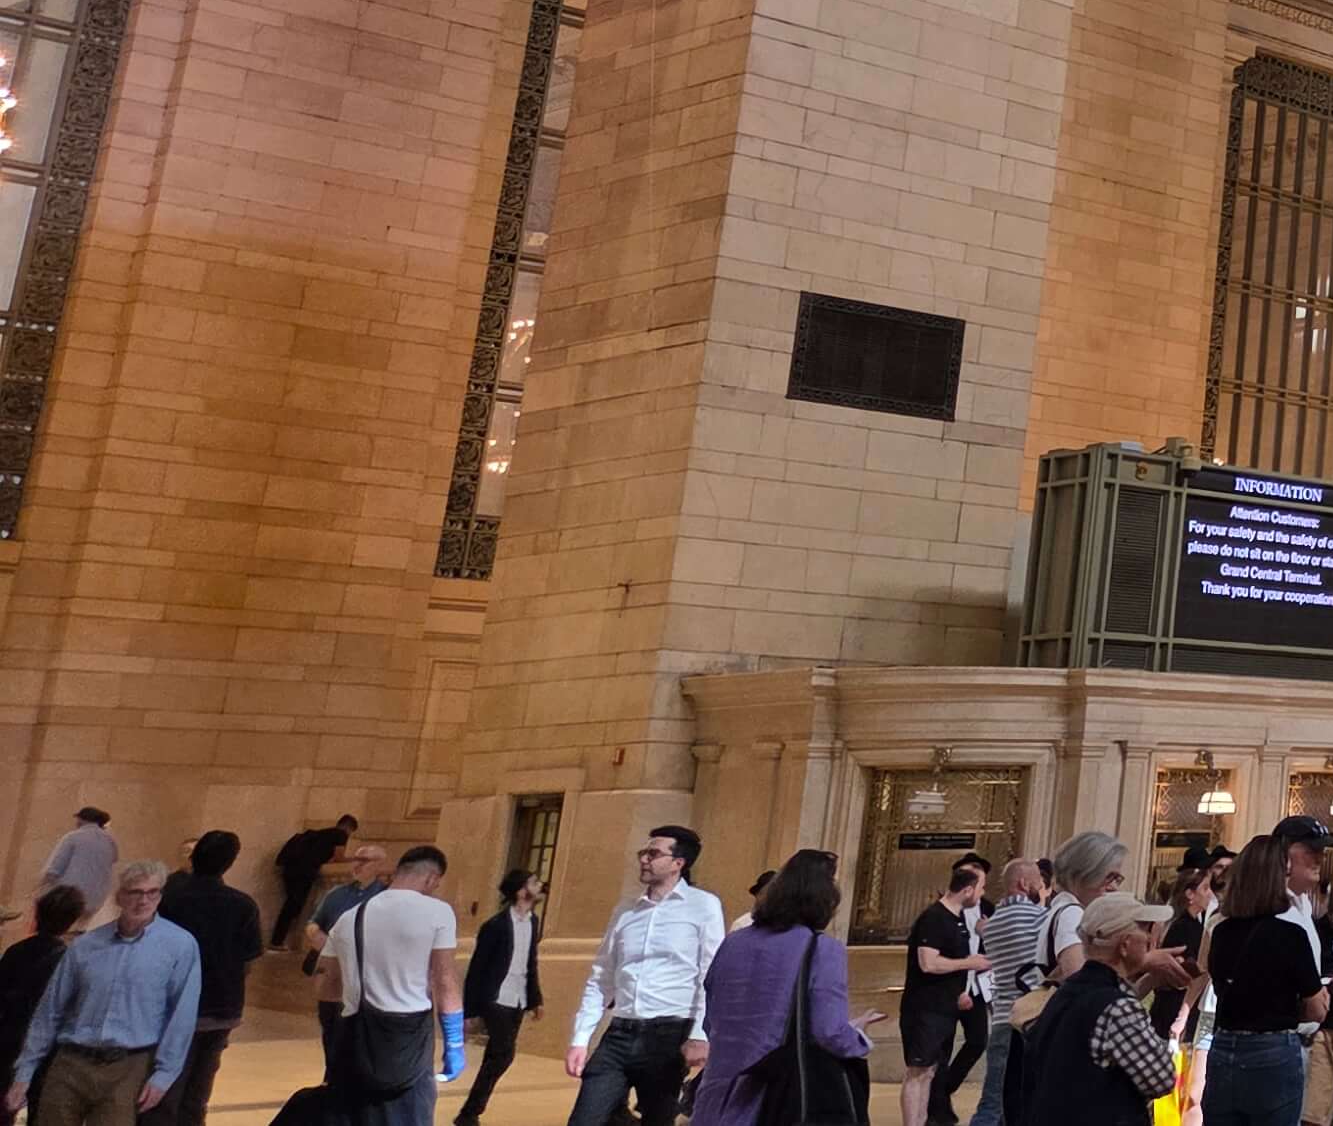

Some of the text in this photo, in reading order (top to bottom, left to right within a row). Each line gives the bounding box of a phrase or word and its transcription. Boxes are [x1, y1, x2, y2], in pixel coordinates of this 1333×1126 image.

[1235, 477, 1323, 502] INFORMATION
[1230, 506, 1269, 522] Attention
[1189, 521, 1205, 534] For
[1206, 525, 1226, 537] your
[1228, 526, 1255, 541] safety
[1257, 530, 1274, 542] and
[1275, 531, 1289, 543] the
[1291, 533, 1317, 549] safety
[1318, 536, 1327, 548] of
[1188, 541, 1219, 555] please
[1220, 544, 1232, 556] do
[1234, 546, 1249, 558] not
[1250, 547, 1261, 559] sit
[1262, 550, 1274, 561] on
[1275, 550, 1289, 563] the
[1291, 552, 1310, 565] floor
[1311, 556, 1321, 566] or
[1220, 563, 1249, 578] Grand
[1250, 566, 1282, 581] Central
[1201, 581, 1230, 596] Thank
[1231, 585, 1248, 598] you
[1250, 586, 1262, 599] for
[1264, 589, 1283, 602] your
